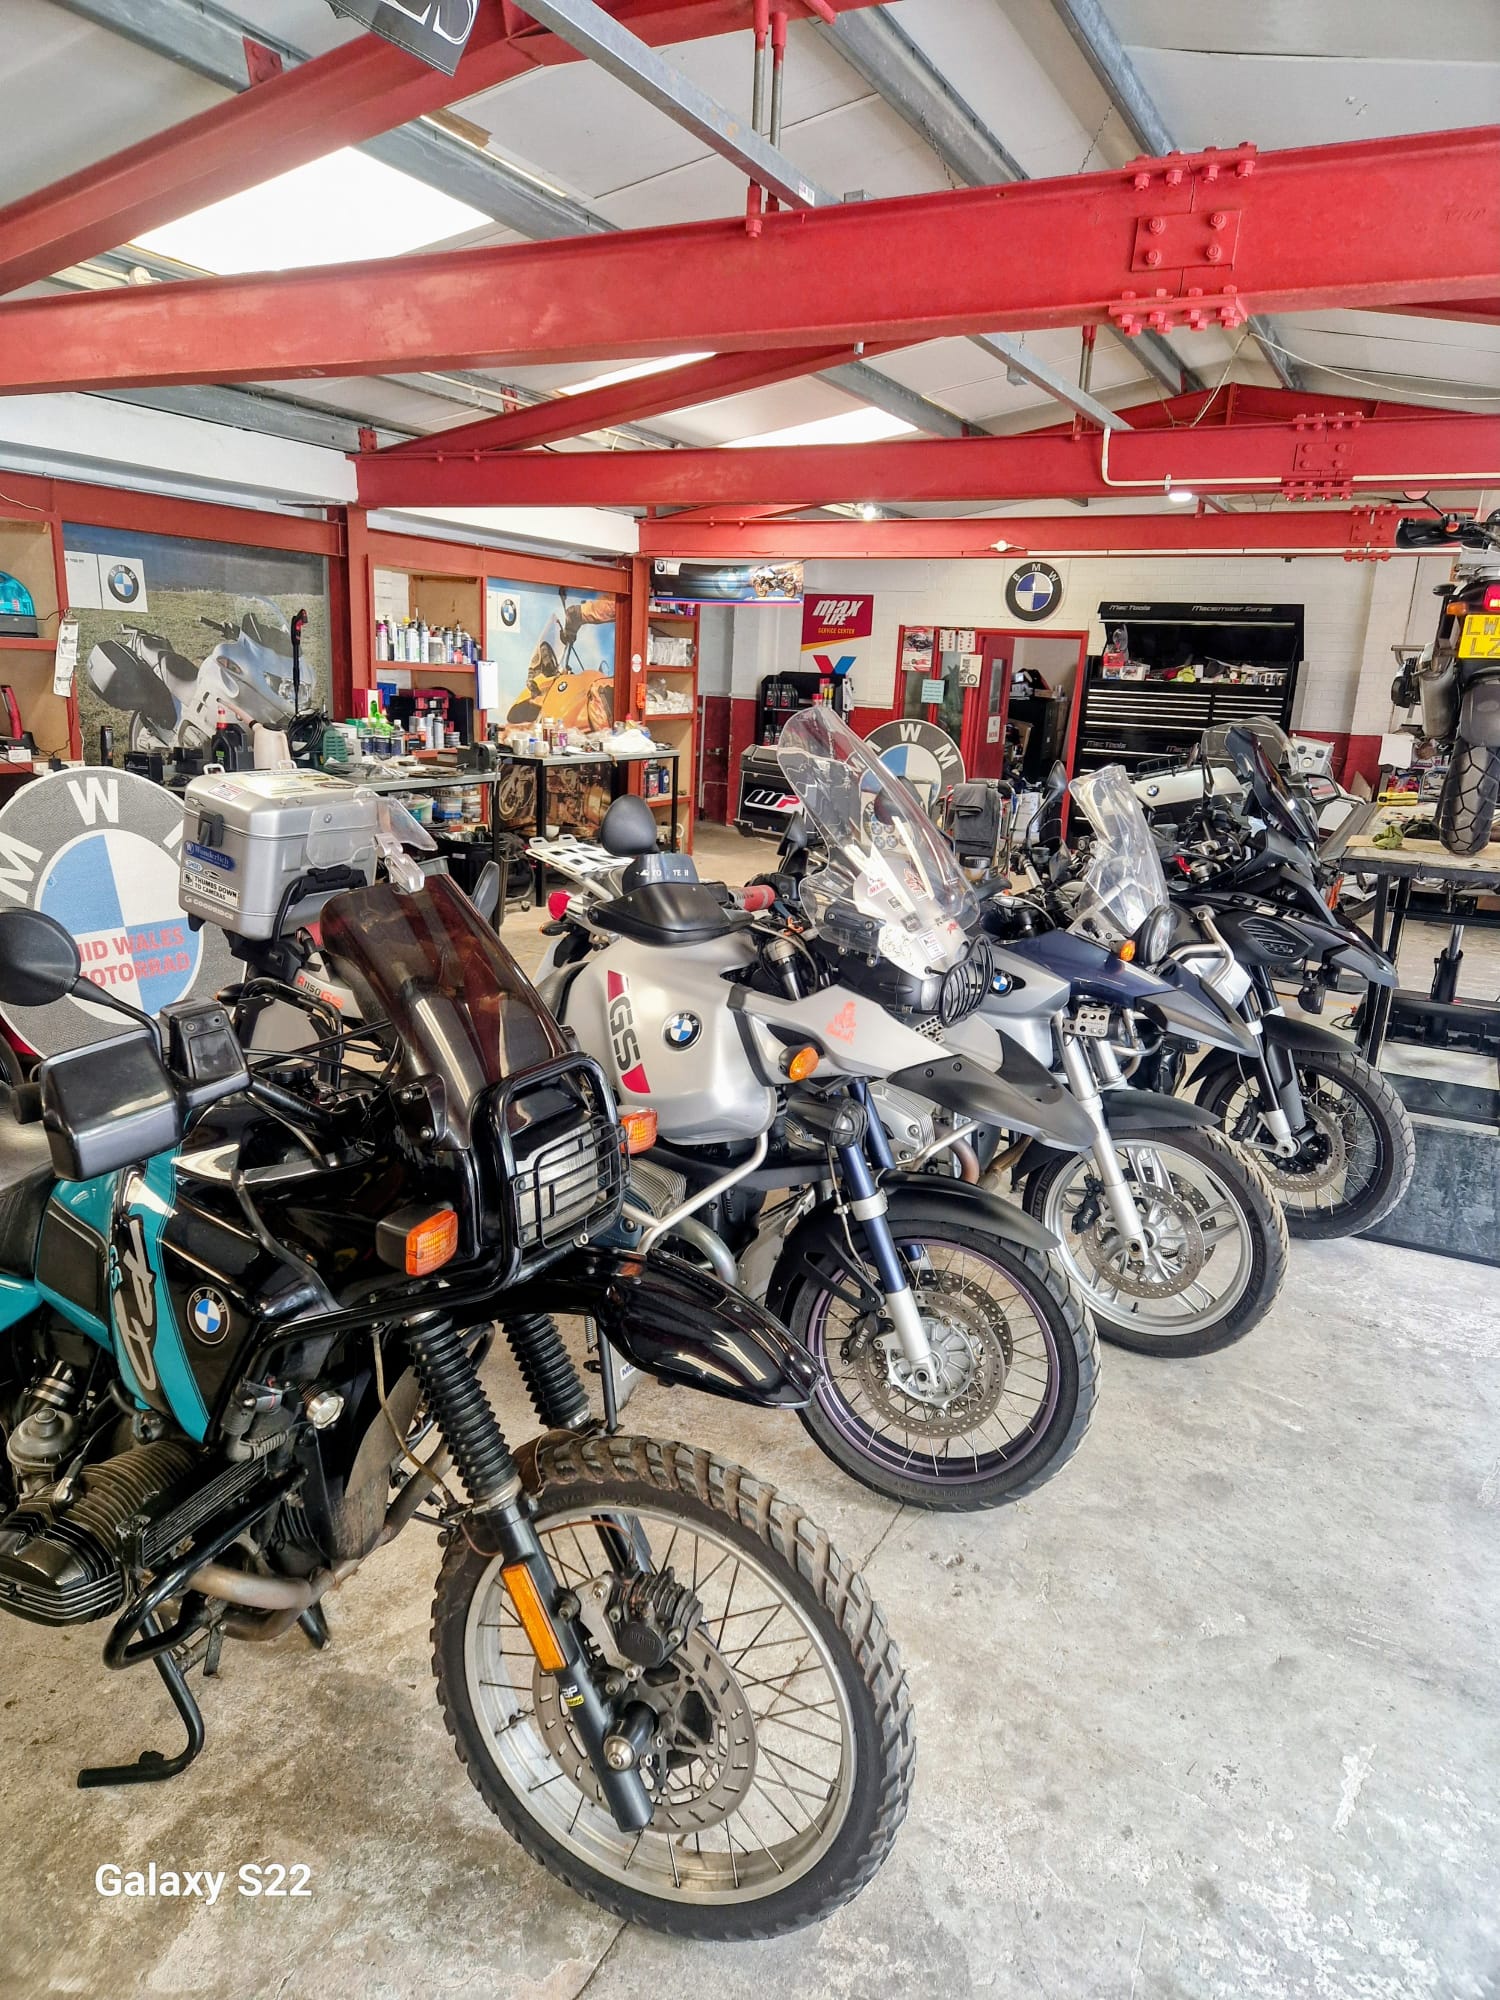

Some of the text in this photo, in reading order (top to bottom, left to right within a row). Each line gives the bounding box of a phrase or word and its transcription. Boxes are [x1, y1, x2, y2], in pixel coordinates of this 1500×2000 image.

[822, 612, 848, 626] LIFE
[817, 627, 837, 635] SERVICE
[194, 875, 237, 898] THUMBS DOWN
[202, 886, 226, 900] CAMERAS
[112, 926, 185, 956] WALES
[81, 951, 191, 988] OTORRAD
[609, 996, 641, 1071] GS
[855, 1327, 870, 1350] BMW
